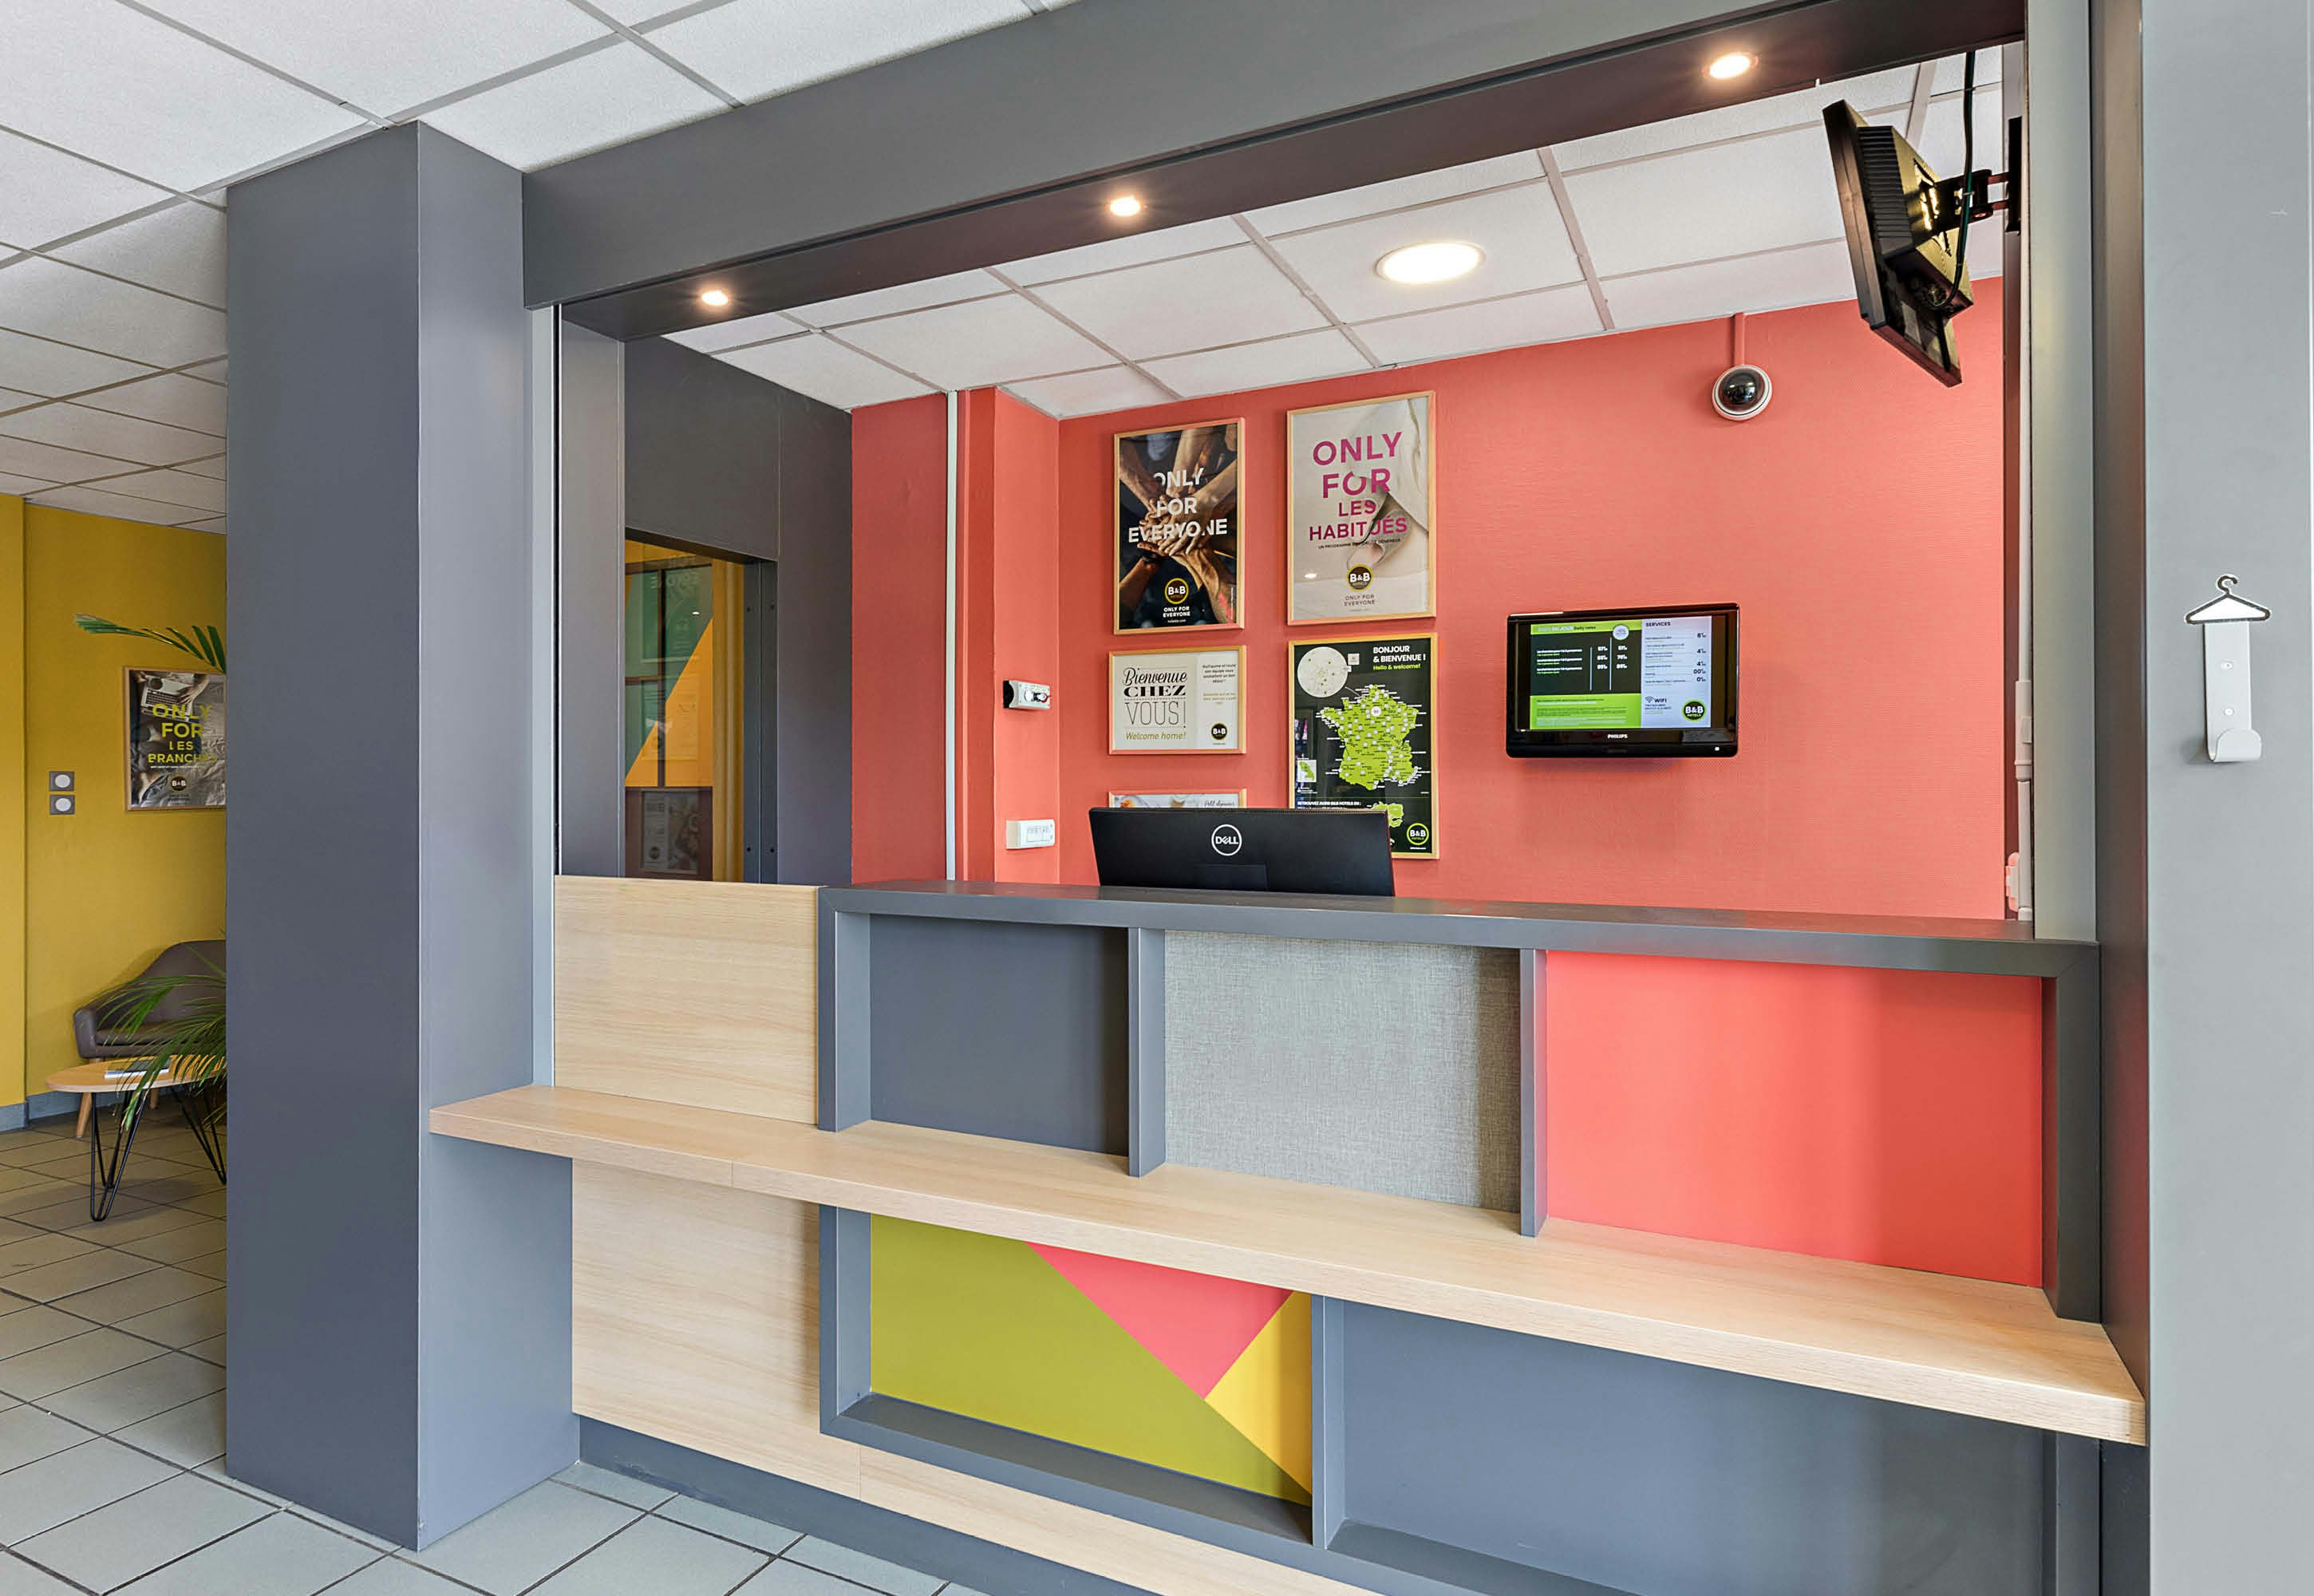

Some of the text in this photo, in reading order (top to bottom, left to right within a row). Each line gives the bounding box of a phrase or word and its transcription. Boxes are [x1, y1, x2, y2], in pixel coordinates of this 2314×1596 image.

[1313, 432, 1403, 466] ONLY
[1153, 468, 1204, 487] ONLY
[1323, 468, 1391, 499] FOR
[1157, 497, 1197, 517] FOR
[1338, 500, 1376, 517] LES
[1128, 518, 1228, 543] EVERYONE
[1349, 572, 1370, 583] B&B
[1167, 586, 1186, 595] B&B
[1373, 645, 1410, 654] BONJOUR
[1380, 654, 1422, 662] BIENVENUE
[1123, 667, 1187, 686] Bienvenue
[1123, 685, 1186, 697] CHEZ
[153, 703, 211, 720] ONLY
[1124, 701, 1186, 729] VOUS!
[161, 722, 204, 738] FOR
[1126, 731, 1187, 741] Welcome home!
[169, 741, 193, 750] LES
